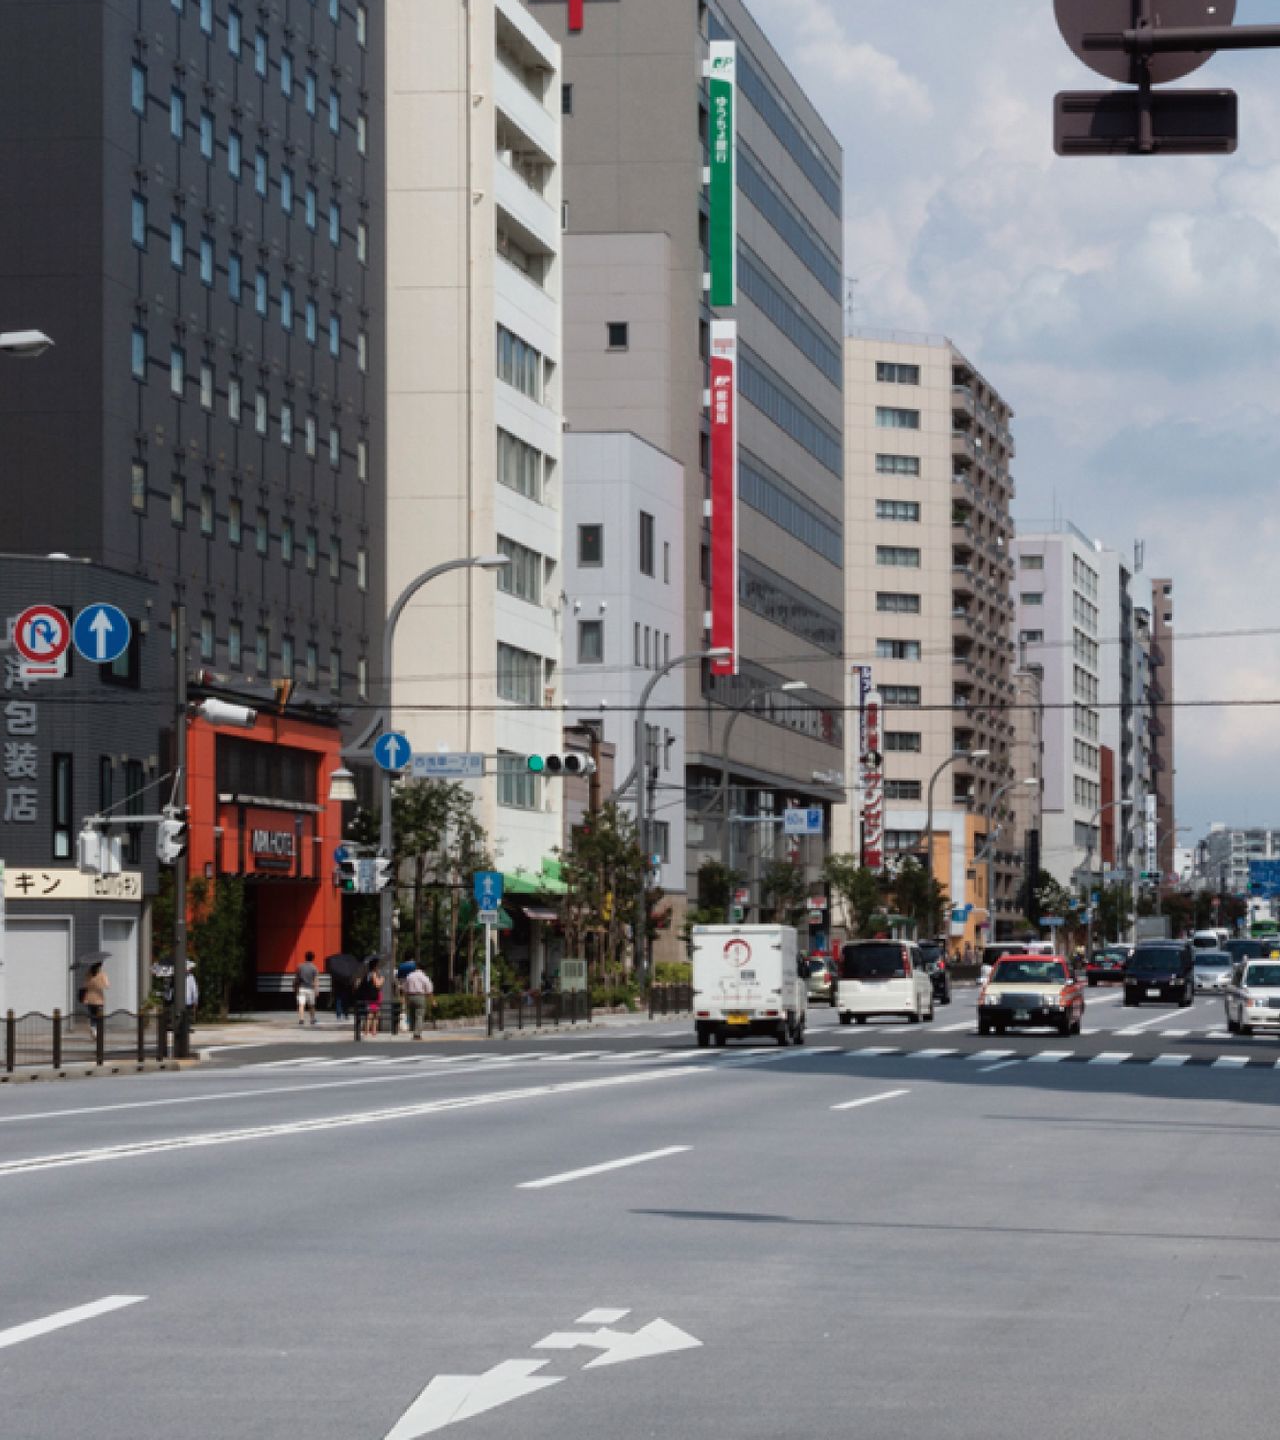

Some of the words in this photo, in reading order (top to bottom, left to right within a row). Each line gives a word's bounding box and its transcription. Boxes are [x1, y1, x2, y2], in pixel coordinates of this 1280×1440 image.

[714, 95, 728, 164] ゆうちょ銀行
[3, 616, 39, 824] 洋包装店
